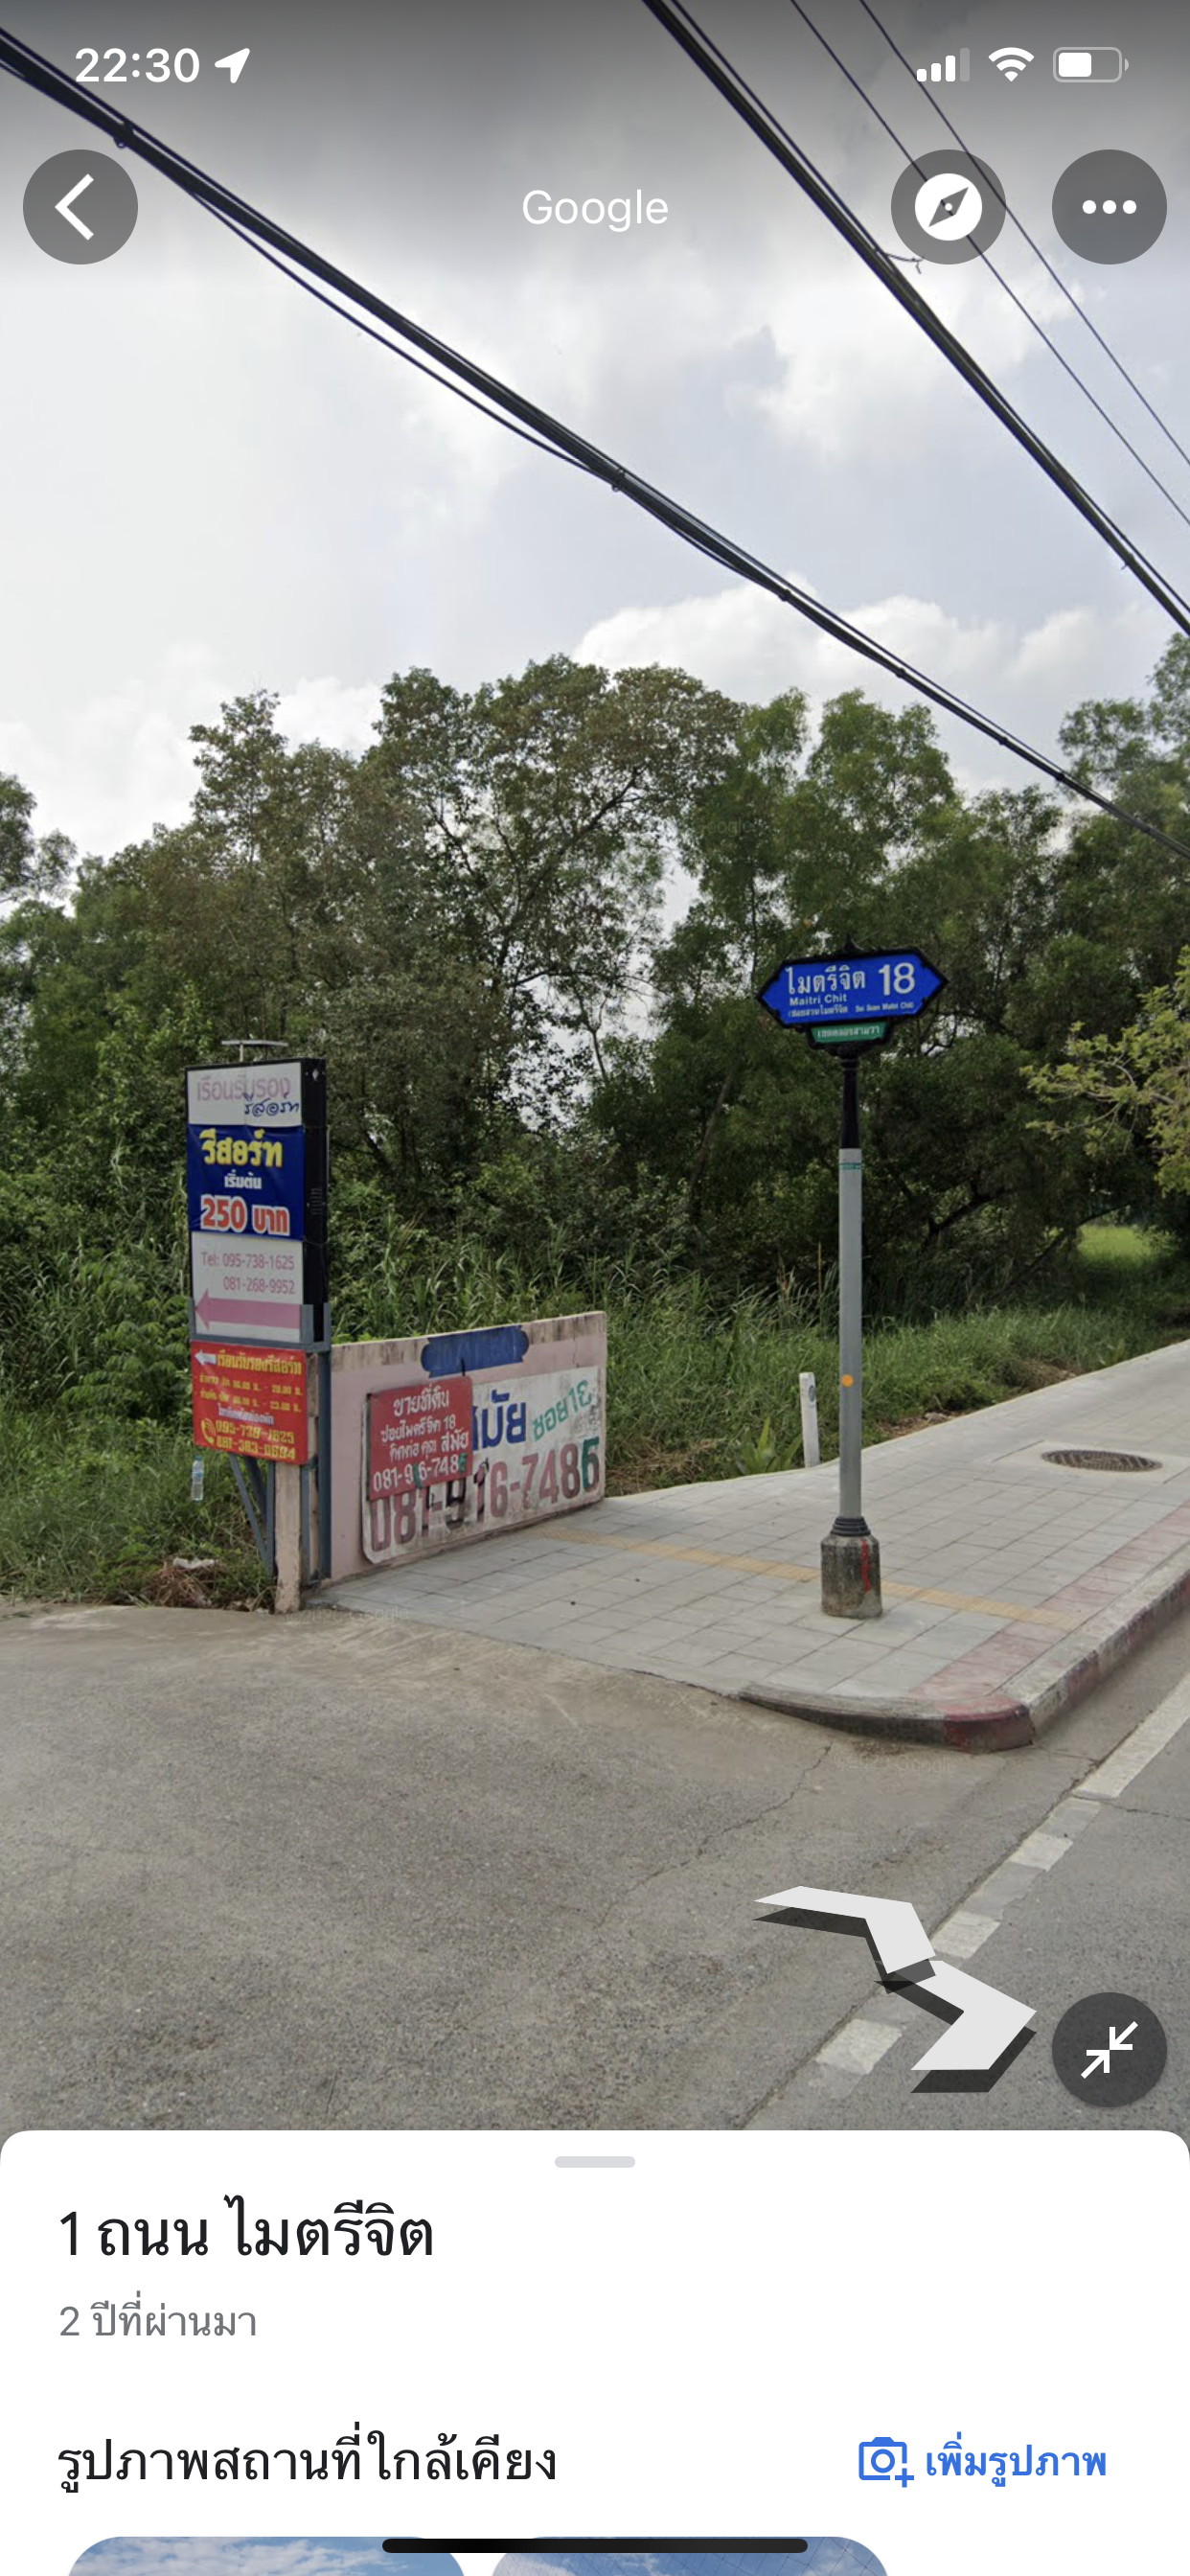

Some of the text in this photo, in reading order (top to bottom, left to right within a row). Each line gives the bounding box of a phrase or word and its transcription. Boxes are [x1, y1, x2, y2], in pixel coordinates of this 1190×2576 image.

[786, 962, 916, 996] ไมตรีจิต 18
[790, 993, 848, 1006] Maitri Chit
[199, 1127, 284, 1167] รีสอร์ท
[224, 1169, 263, 1190] เริ่มต้น
[200, 1194, 290, 1236] 250 บาท
[222, 1253, 295, 1272] 095-738-1625
[223, 1276, 296, 1295] 081-268-9952
[393, 1383, 449, 1416] ขายที่ดิน
[444, 1414, 456, 1430] 18
